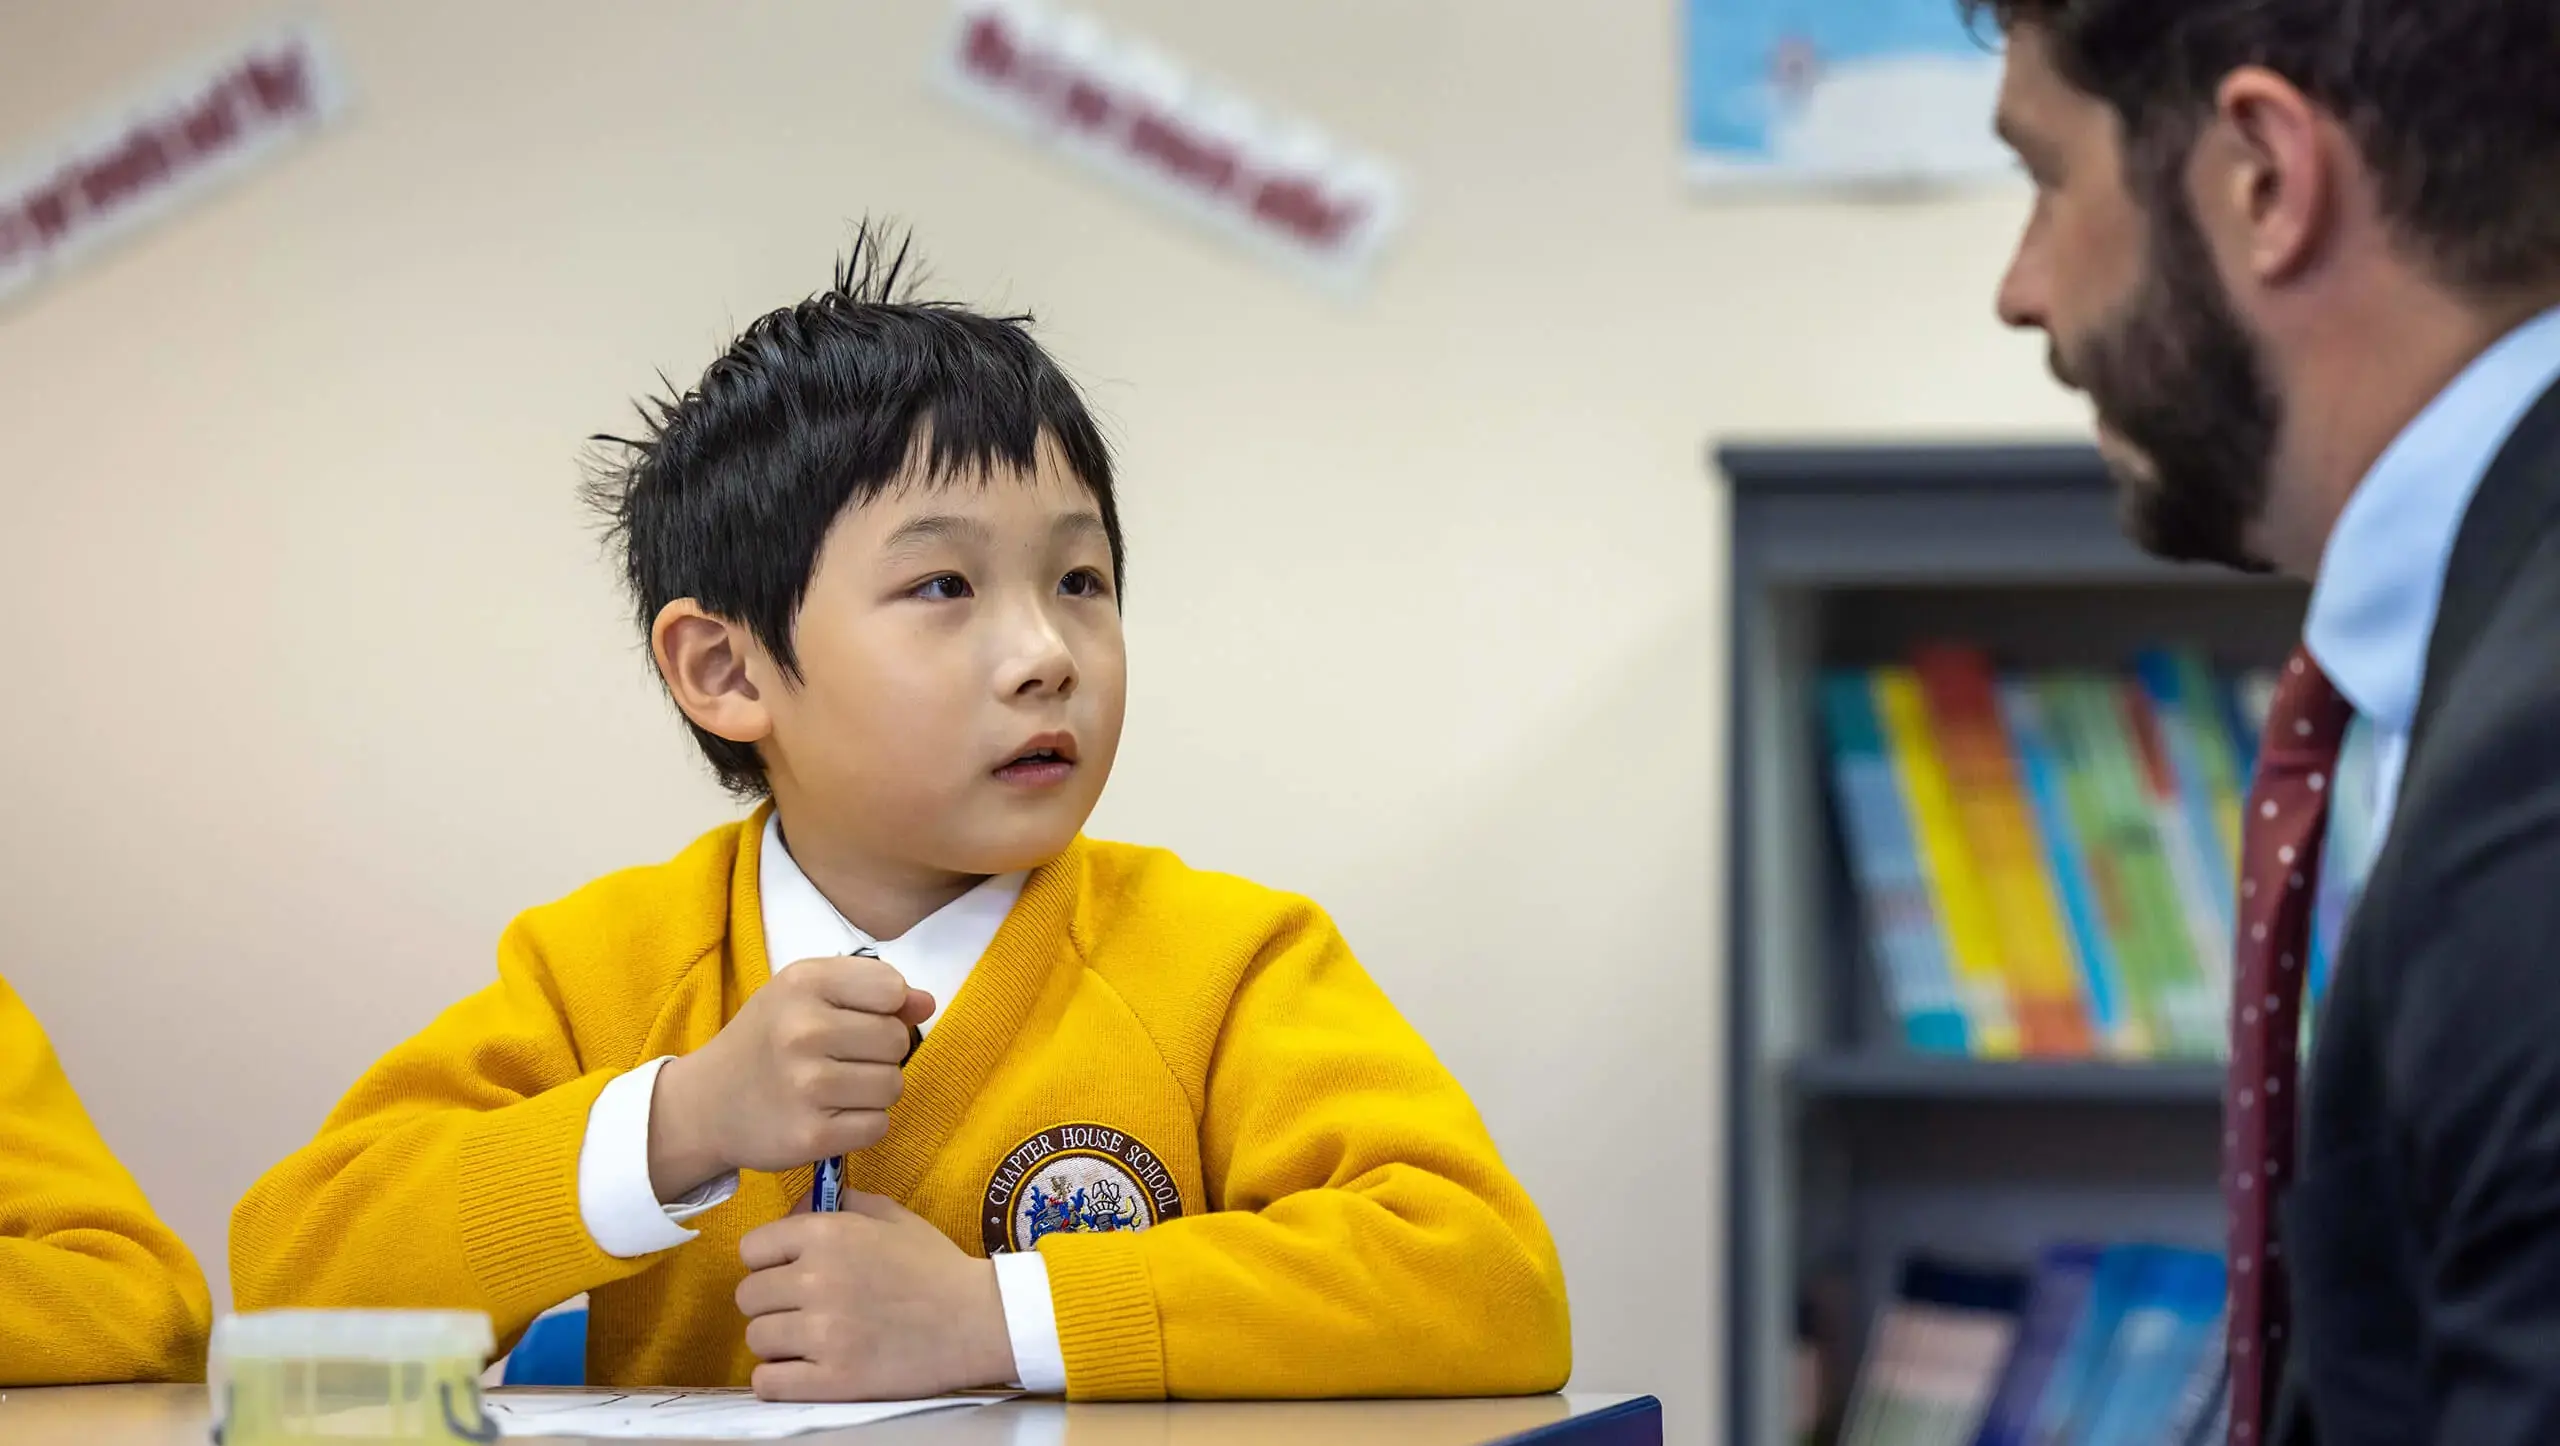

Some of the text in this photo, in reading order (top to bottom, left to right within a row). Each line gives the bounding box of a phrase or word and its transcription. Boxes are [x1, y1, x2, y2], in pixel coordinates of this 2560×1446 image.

[989, 1127, 1179, 1213] CHAPTER HOUSE SCHOOL
